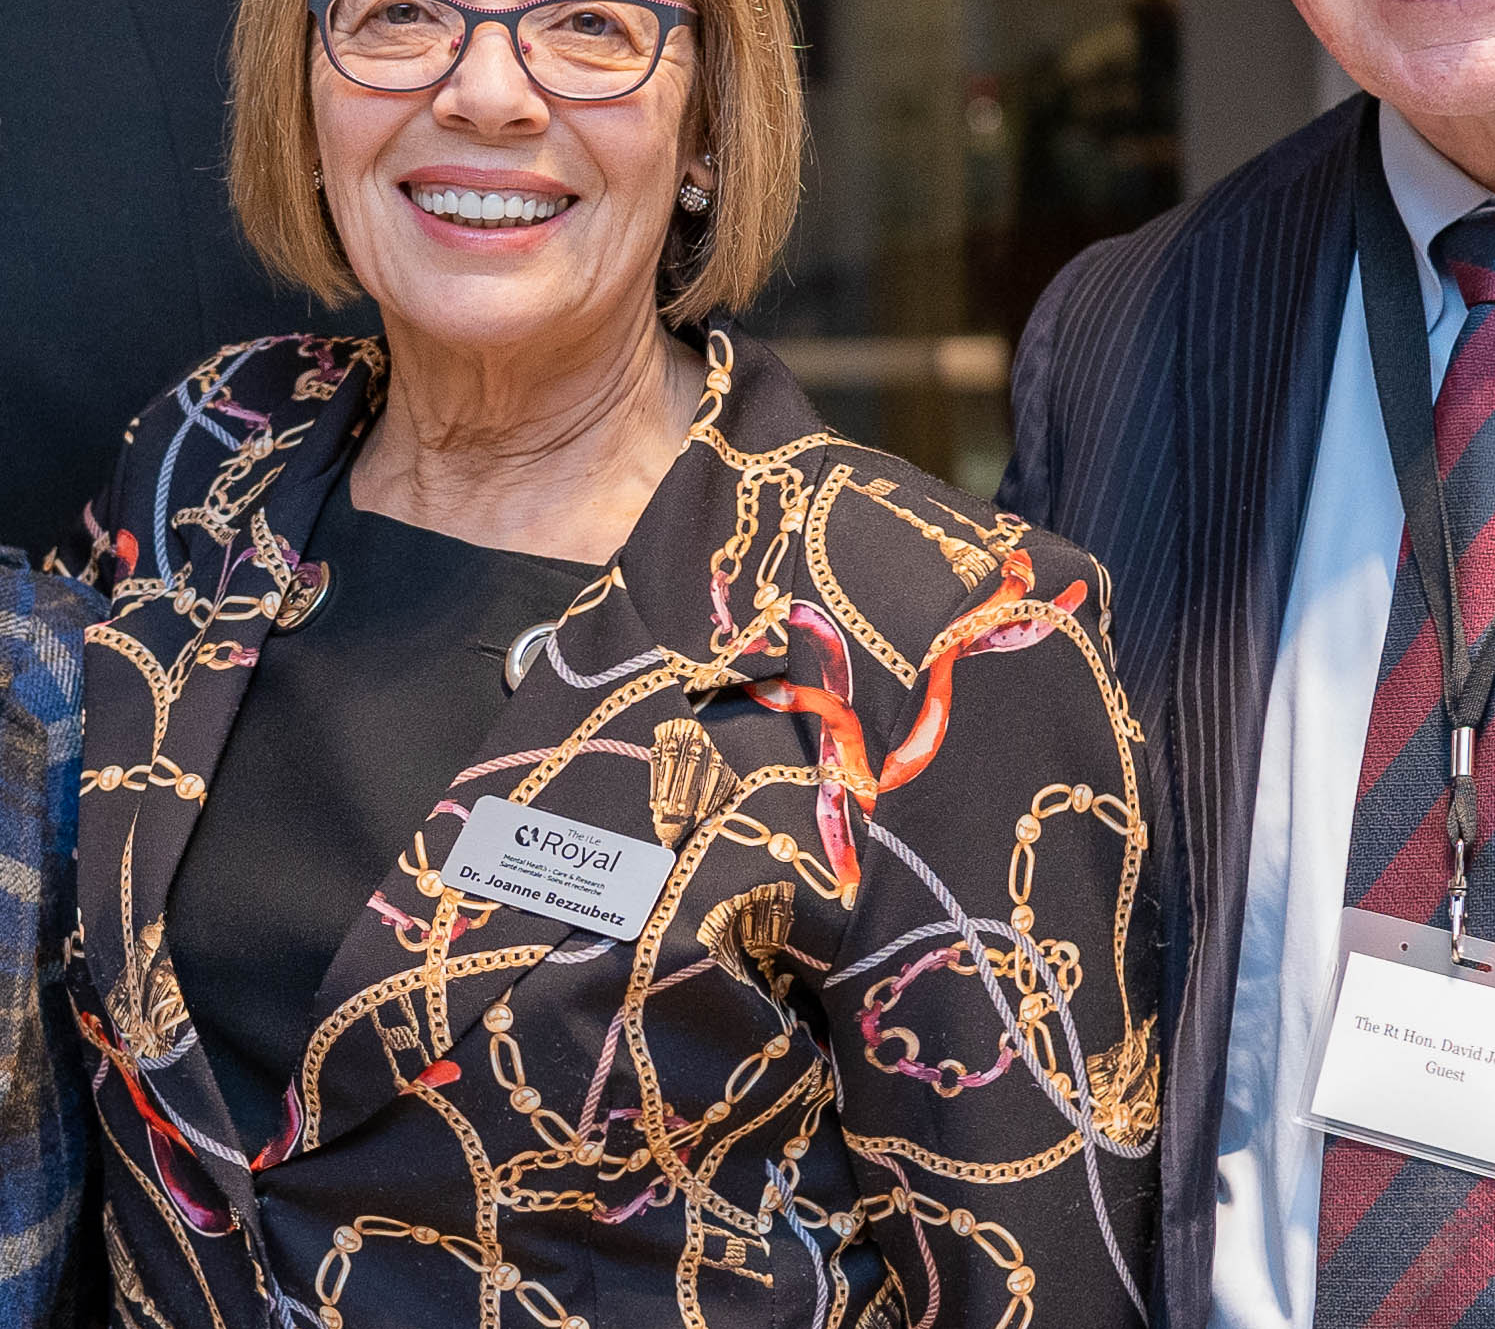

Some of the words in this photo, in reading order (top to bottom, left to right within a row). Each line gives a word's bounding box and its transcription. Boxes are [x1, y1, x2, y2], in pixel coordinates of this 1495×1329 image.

[540, 831, 623, 872] Royal
[568, 828, 584, 841] The
[459, 865, 481, 882] Dr.
[485, 874, 541, 901] Joanne
[545, 892, 626, 927] Bezzubetz
[1354, 1015, 1381, 1035] The
[1383, 1022, 1400, 1039] Rt
[1403, 1029, 1437, 1050] Hon.
[1440, 1038, 1483, 1061] David
[1425, 1061, 1466, 1083] Guest
